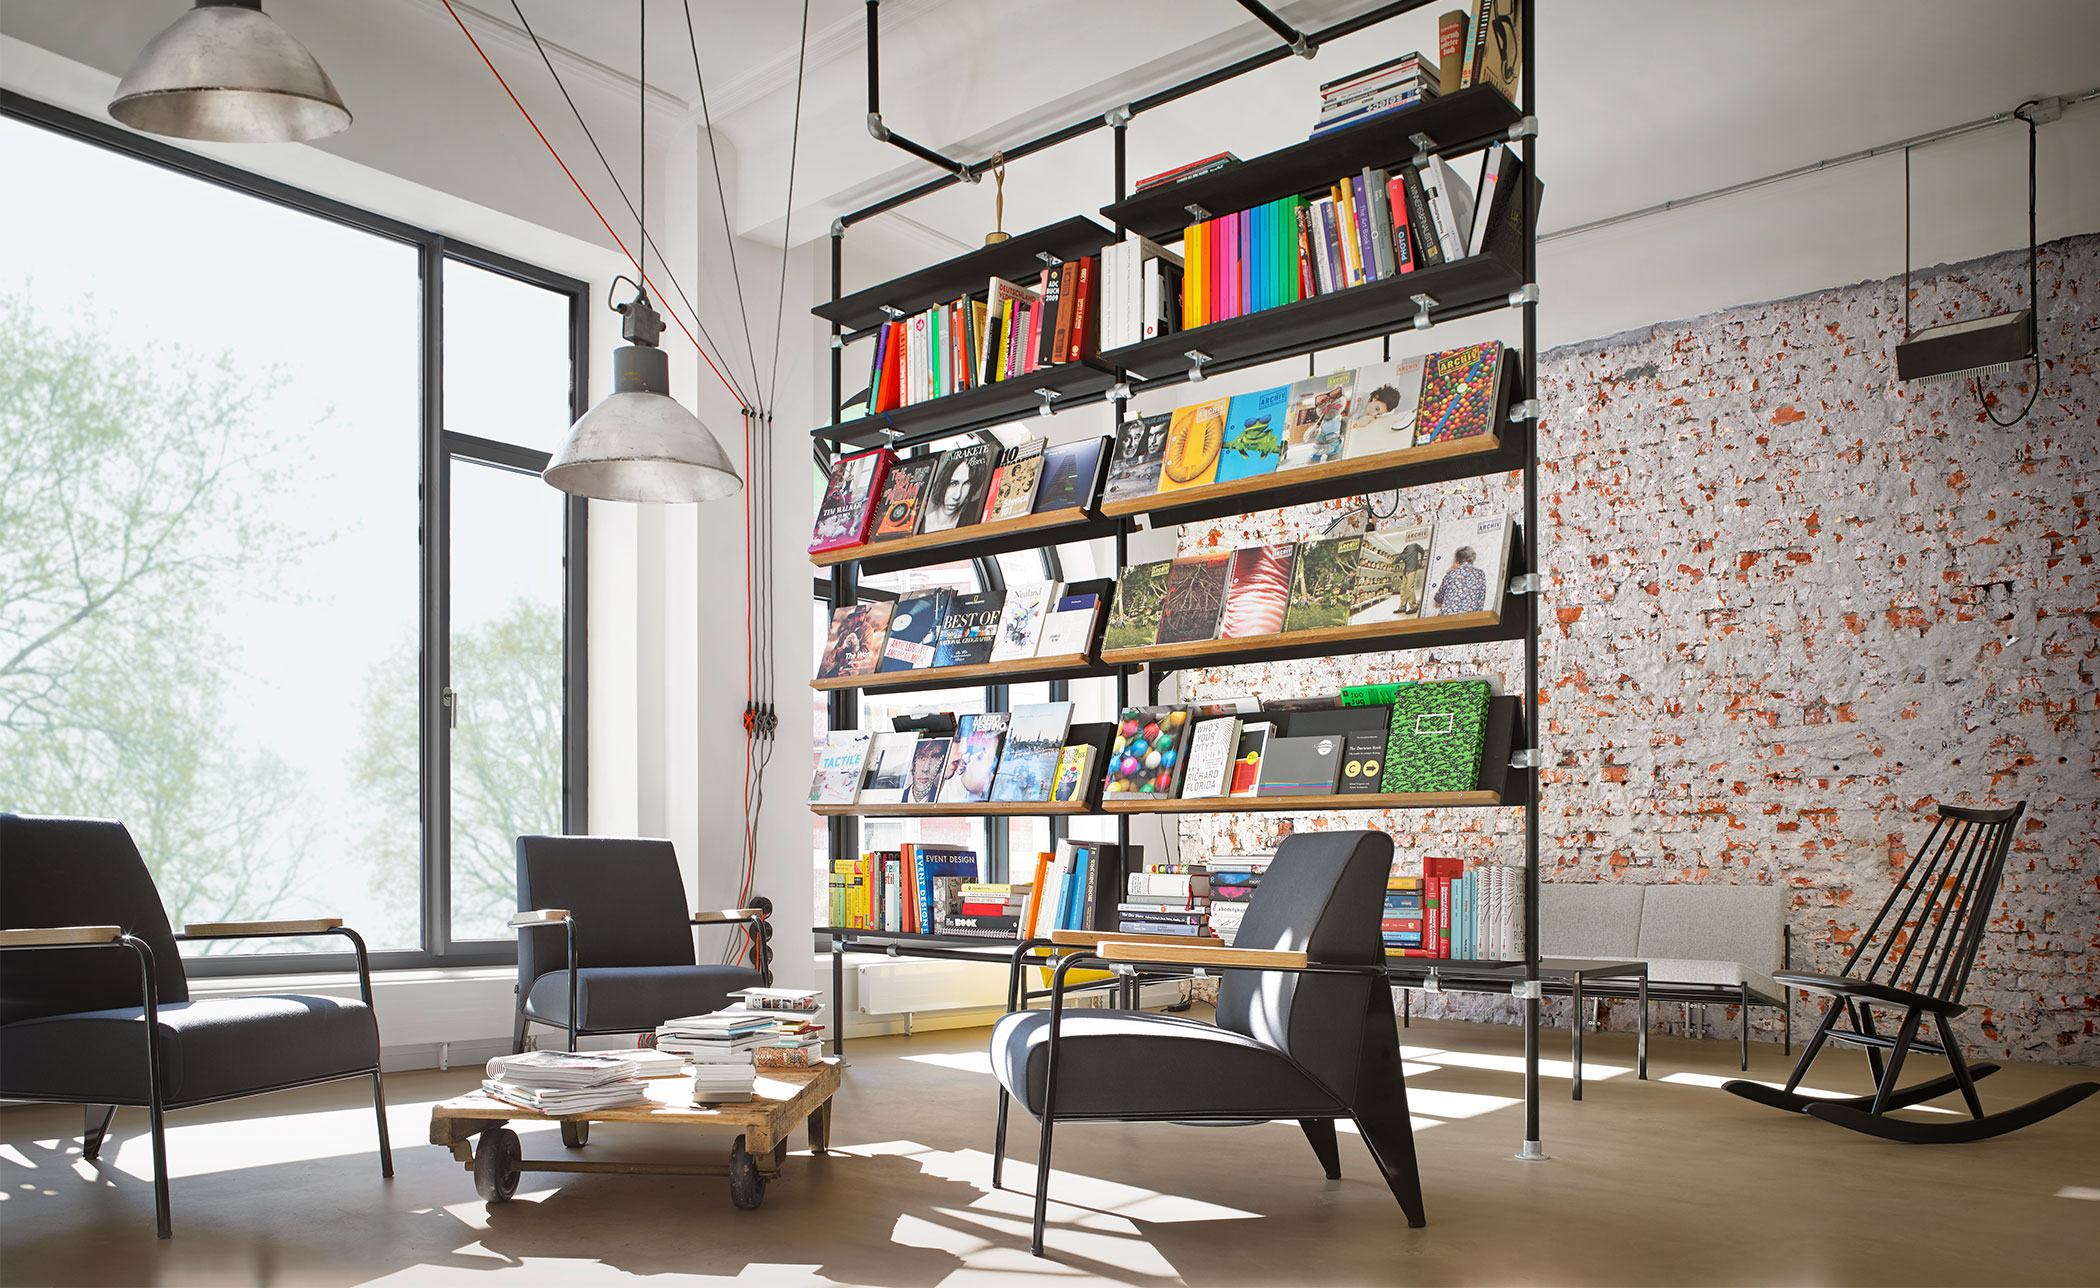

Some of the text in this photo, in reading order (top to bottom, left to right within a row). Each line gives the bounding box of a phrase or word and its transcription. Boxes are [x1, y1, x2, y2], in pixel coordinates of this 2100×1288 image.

[1399, 232, 1408, 261] PHOTO
[1440, 350, 1478, 371] ARCHIV
[1260, 393, 1286, 406] ARCHIV
[1198, 404, 1224, 418] ARCHIV
[956, 444, 990, 460] RAKETE
[1479, 523, 1500, 532] ARCHIV
[1407, 531, 1427, 539] ARCHIV
[944, 610, 1000, 629] BEST OF
[973, 714, 1002, 725] MARIO
[972, 722, 1007, 732] TESTINO
[1197, 722, 1220, 734] WHO'S
[1197, 732, 1216, 743] YOUR
[1194, 742, 1214, 752] CITY?
[824, 754, 862, 768] TACTILE
[1187, 770, 1219, 782] RICHARD
[1186, 780, 1216, 792] FLORIDA
[950, 856, 975, 864] DESIGN
[917, 855, 925, 886] EVENT
[920, 890, 928, 926] DESIGN
[954, 918, 978, 927] BOOK
